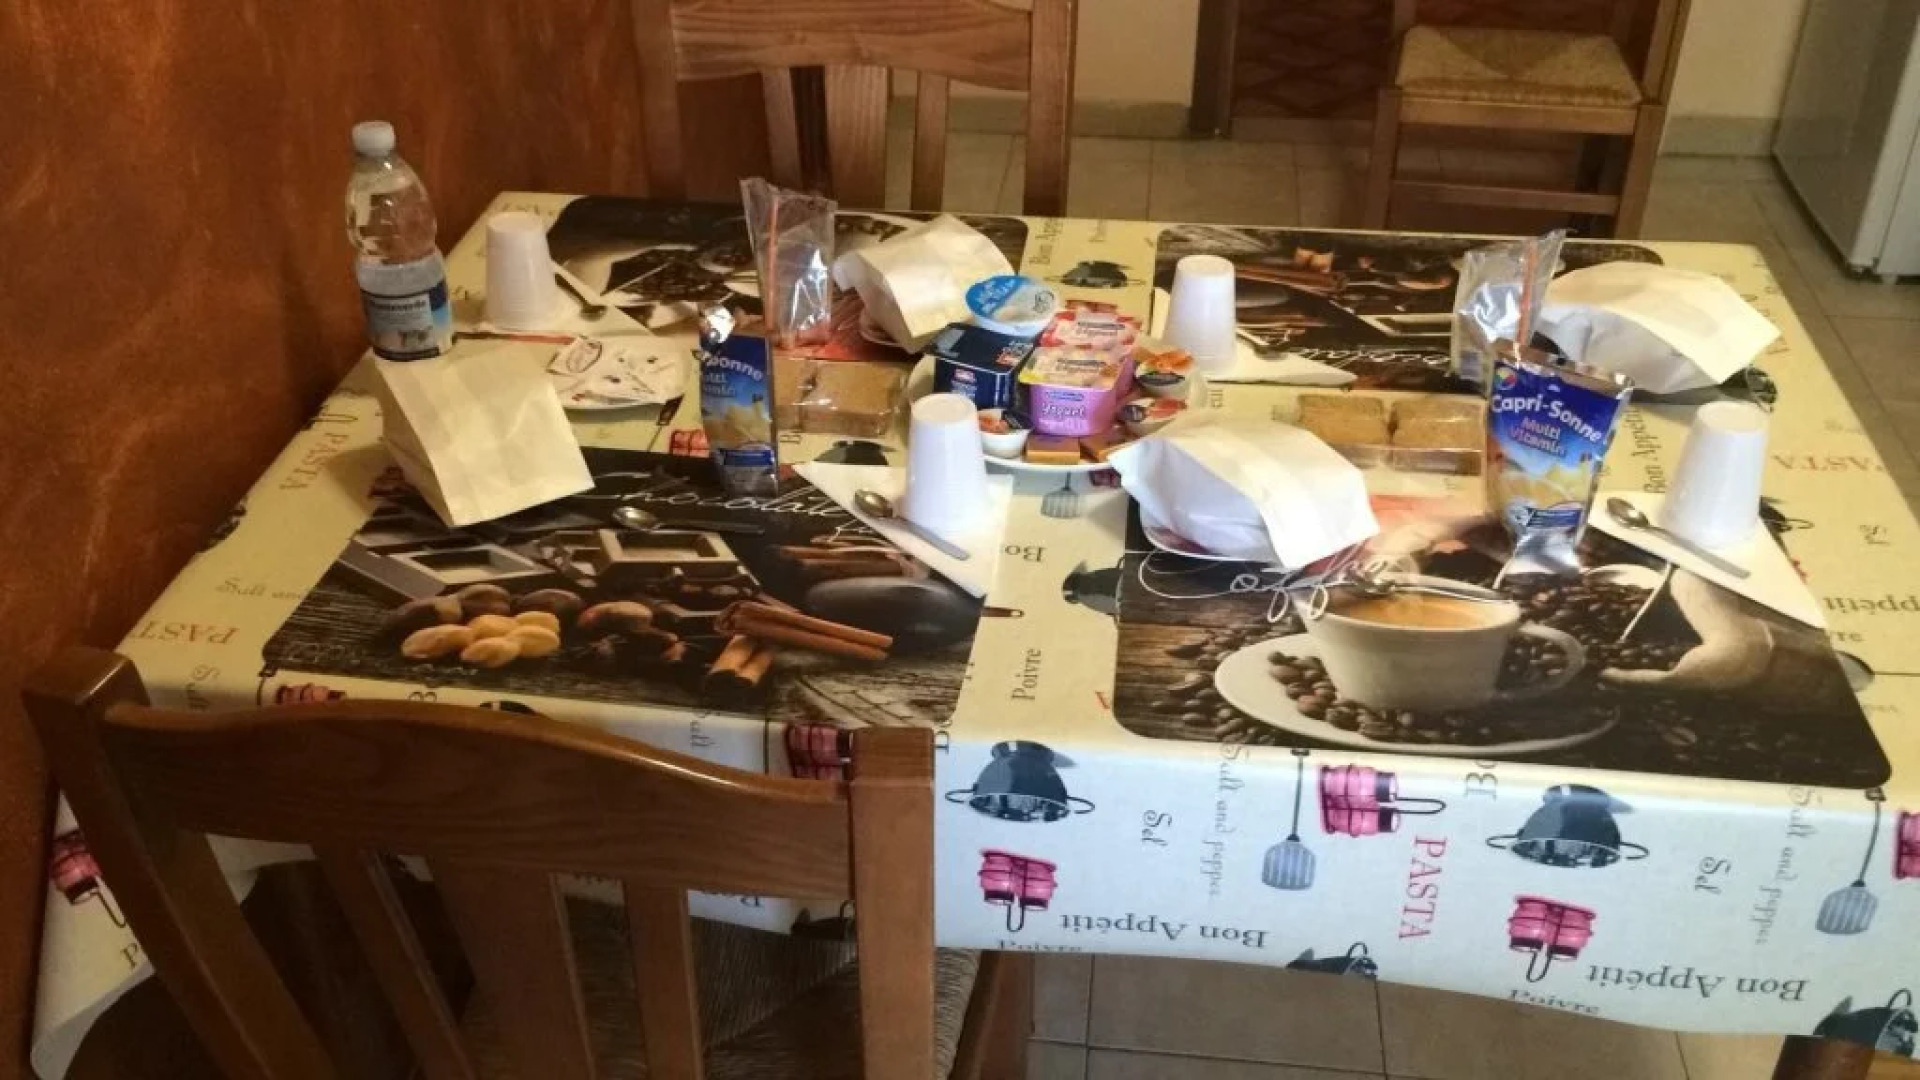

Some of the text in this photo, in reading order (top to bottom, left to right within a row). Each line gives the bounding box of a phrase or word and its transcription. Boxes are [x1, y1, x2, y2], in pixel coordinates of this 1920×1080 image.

[1491, 393, 1602, 443] Capri-Sonne
[1011, 648, 1042, 701] Poivre
[1398, 835, 1448, 938] PASTA
[1061, 912, 1270, 949] Bon Appétit
[1588, 964, 1810, 1002] Bon Appétit
